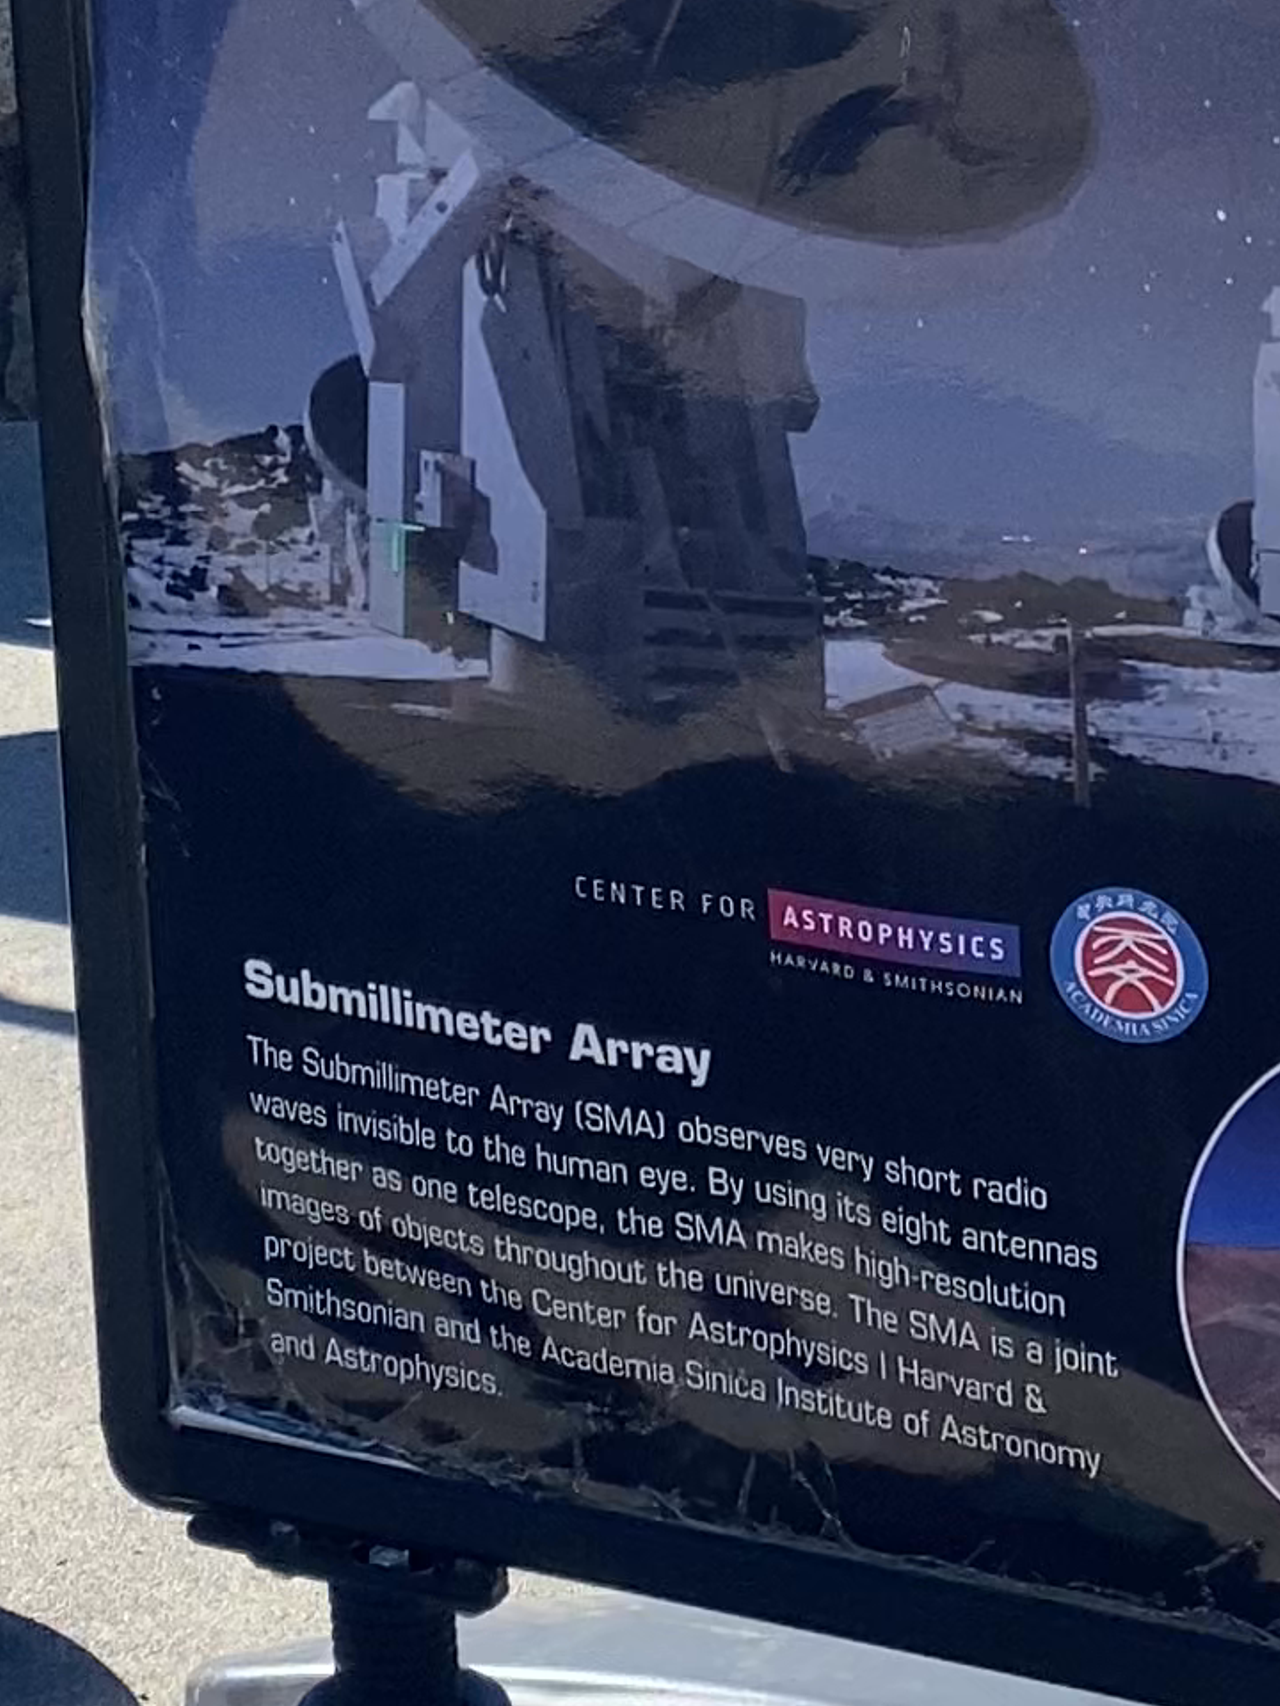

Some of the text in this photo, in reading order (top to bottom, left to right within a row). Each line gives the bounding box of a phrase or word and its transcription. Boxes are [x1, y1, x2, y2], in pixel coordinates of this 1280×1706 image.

[574, 875, 1006, 962] CENTER FOR ASTROPHYSICS
[770, 951, 1024, 1005] HARVARD & SMITHSONIAN
[243, 958, 712, 1087] Submillimeter Array
[1064, 981, 1199, 1036] ACADEMIA SINICA
[246, 1035, 1047, 1210] The Submillimeter Array (SMA) observes very short radio
[250, 1092, 1098, 1270] waves invisible to the human eye. By using its eight antennas
[255, 1137, 1066, 1318] together as one telescope, the SMA makes high-resolution
[261, 1185, 1118, 1377] images of objects throughout the universe. The SMA is a joint
[264, 1235, 355, 1272] project
[364, 1251, 472, 1297] between
[480, 1278, 522, 1310] the
[532, 1288, 625, 1328] Center
[637, 1305, 677, 1336] for
[688, 1311, 868, 1375] Astrophysics
[897, 1355, 1013, 1408] Harvard
[1025, 1384, 1047, 1414] &
[267, 1277, 1101, 1479] Smithsonian and the Academia Sinica Institute of Astronomy
[270, 1332, 503, 1397] and Astrophysics.
